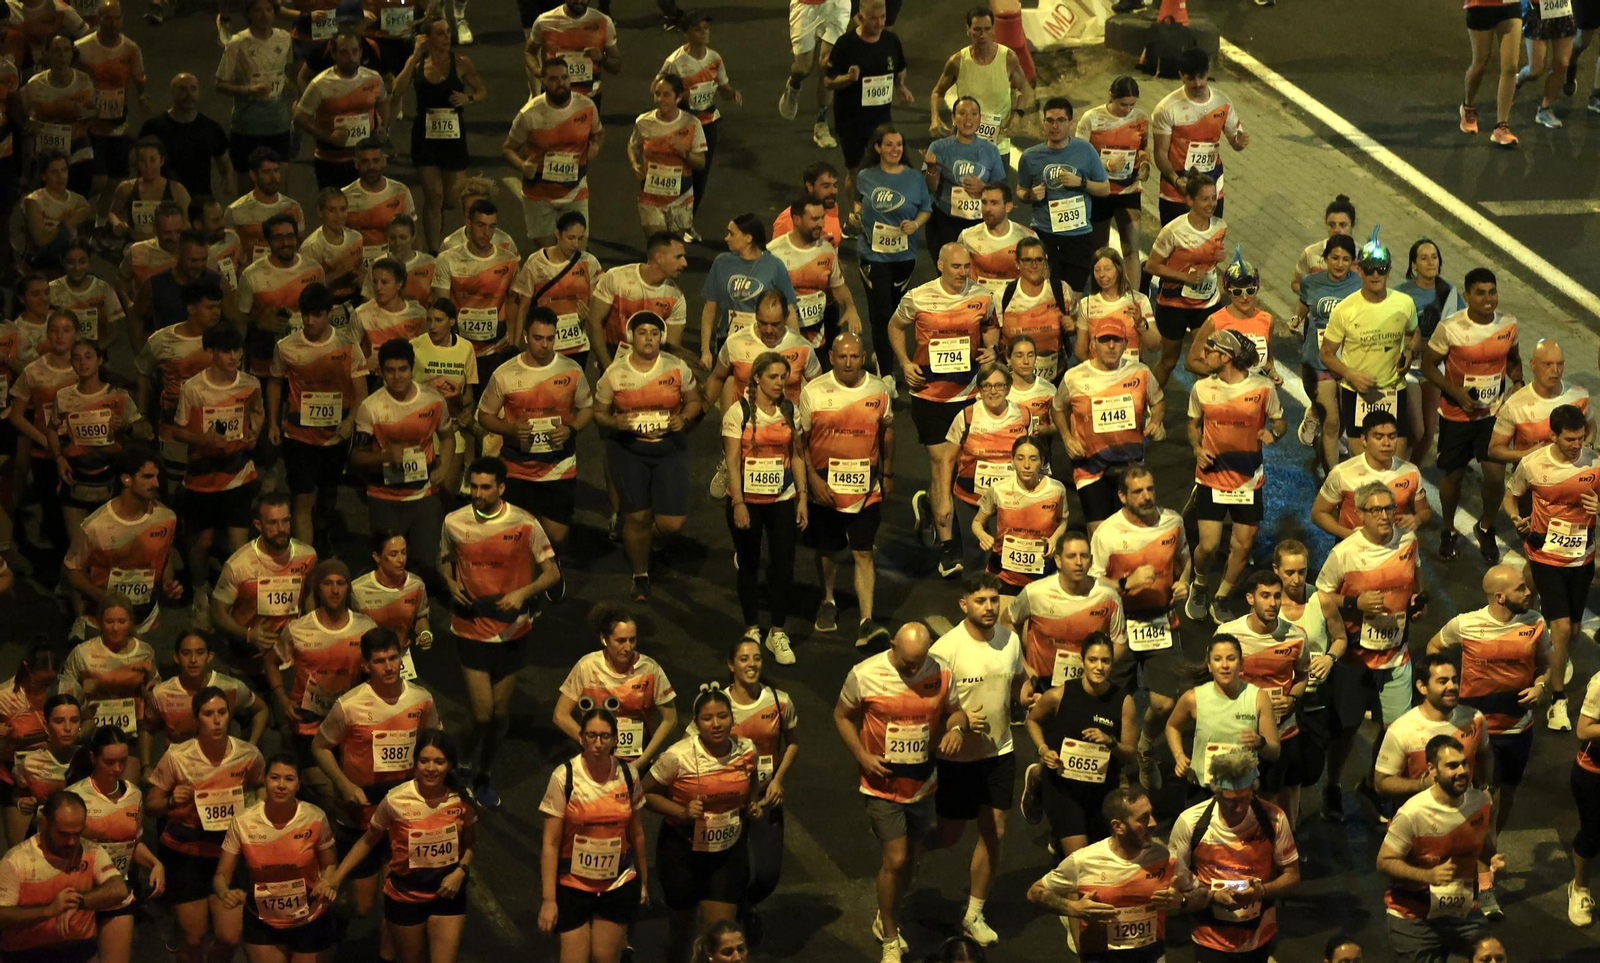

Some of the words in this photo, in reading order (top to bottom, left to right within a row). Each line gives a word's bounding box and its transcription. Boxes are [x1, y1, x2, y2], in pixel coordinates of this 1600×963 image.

[568, 64, 586, 74] 539
[692, 93, 713, 103] 1255
[866, 87, 889, 98] 19087
[432, 120, 454, 131] 8176
[978, 124, 996, 136] 800
[40, 134, 66, 146] 15981
[1190, 154, 1216, 164] 12870
[547, 163, 575, 174] 14491
[959, 164, 974, 175] life
[650, 175, 677, 188] 14489
[876, 191, 893, 203] life
[957, 200, 980, 211] 2832
[137, 215, 154, 224] 133
[1058, 210, 1080, 222] 2839
[879, 236, 902, 246] 2851
[494, 266, 508, 275] KH7
[734, 279, 751, 291] life
[656, 301, 670, 310] KH7
[1323, 300, 1337, 312] lif
[462, 321, 493, 331] 12478
[1360, 332, 1402, 343] NOCTURNA
[1498, 331, 1511, 340] KH7
[937, 352, 962, 363] 7794
[554, 377, 570, 386] KH7
[659, 377, 674, 385] KH7
[1123, 379, 1140, 388] KH7
[866, 400, 880, 409] KH7
[309, 406, 334, 417] 7703
[1100, 411, 1126, 422] 4148
[75, 425, 107, 436] 15690
[749, 473, 780, 483] 14866
[833, 473, 865, 484] 14852
[1578, 474, 1595, 484] KH7
[1394, 480, 1410, 489] KH7
[1042, 501, 1057, 510] KH7
[150, 528, 166, 538] KH7
[503, 532, 522, 541] KH7
[1162, 536, 1176, 545] KH7
[1550, 532, 1582, 548] 24255
[1008, 552, 1035, 564] 4330
[290, 563, 308, 572] KH7
[114, 584, 148, 595] 19760
[267, 592, 293, 604] 1364
[1090, 608, 1108, 617] KH7
[1132, 627, 1165, 640] 11484
[1367, 628, 1399, 639] 11867
[1519, 629, 1535, 637] KH7
[1063, 666, 1083, 678] 139
[631, 681, 648, 690] KH7
[408, 709, 423, 718] KH7
[761, 711, 777, 719] KH7
[94, 715, 129, 727] 21149
[890, 740, 926, 752] 23102
[381, 747, 409, 760] 3887
[1068, 756, 1098, 771] 6655
[204, 806, 235, 819] 3884
[700, 828, 735, 842] 10068
[414, 843, 452, 857] 17540
[578, 854, 614, 867] 10177
[262, 896, 300, 910] 17541
[1114, 921, 1151, 937] 12091
